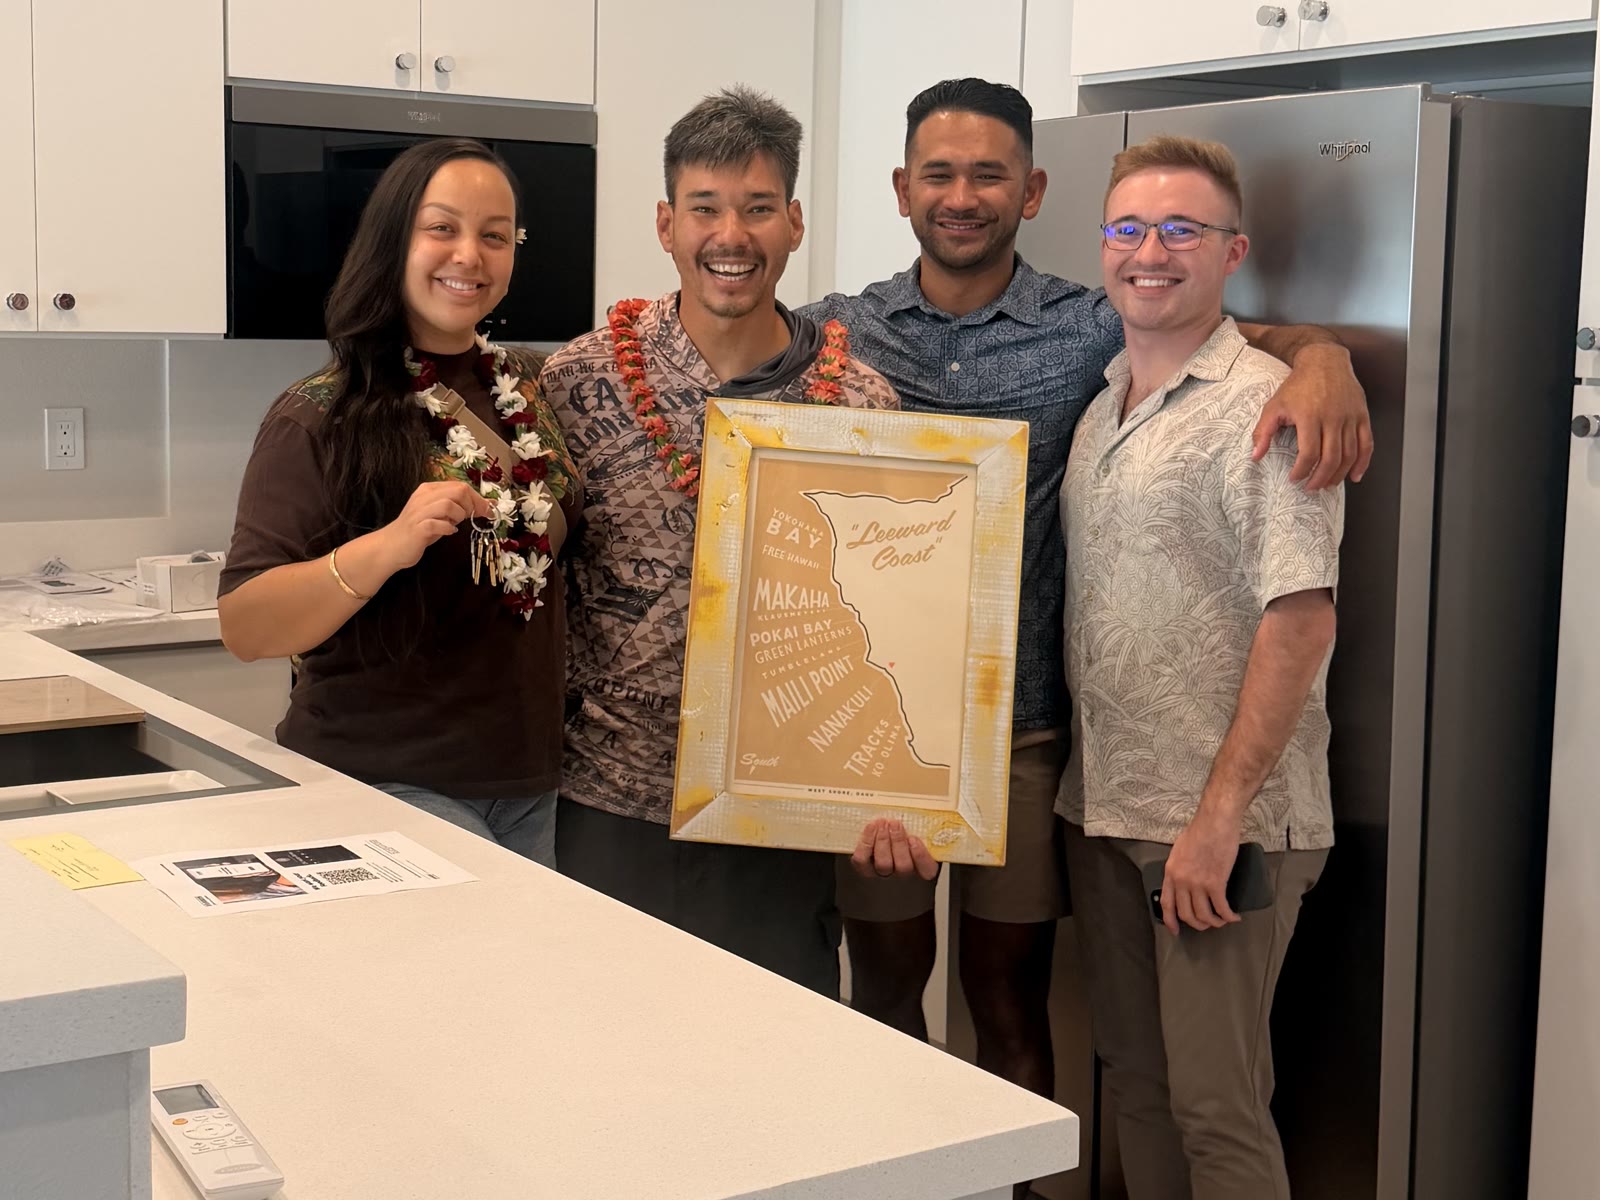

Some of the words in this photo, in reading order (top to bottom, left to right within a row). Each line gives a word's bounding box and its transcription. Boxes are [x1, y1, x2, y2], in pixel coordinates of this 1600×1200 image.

[1319, 141, 1371, 159] Whirlpool
[766, 517, 821, 549] BAY
[846, 509, 957, 550] "Leeward
[762, 544, 785, 560] FREE
[787, 553, 820, 569] HAWAII
[871, 536, 943, 571] Coast"
[753, 577, 830, 611] MAKAHA
[749, 625, 799, 647] POKAI
[803, 619, 832, 635] BAY
[754, 643, 793, 664] GREEN
[796, 626, 852, 651] LANTERNS
[760, 676, 814, 728] MAILI
[808, 655, 854, 695] POINT
[807, 685, 873, 753] NANAKULI
[843, 719, 889, 777] TRACKS
[871, 762, 885, 778] KO
[882, 724, 902, 758] OLINA
